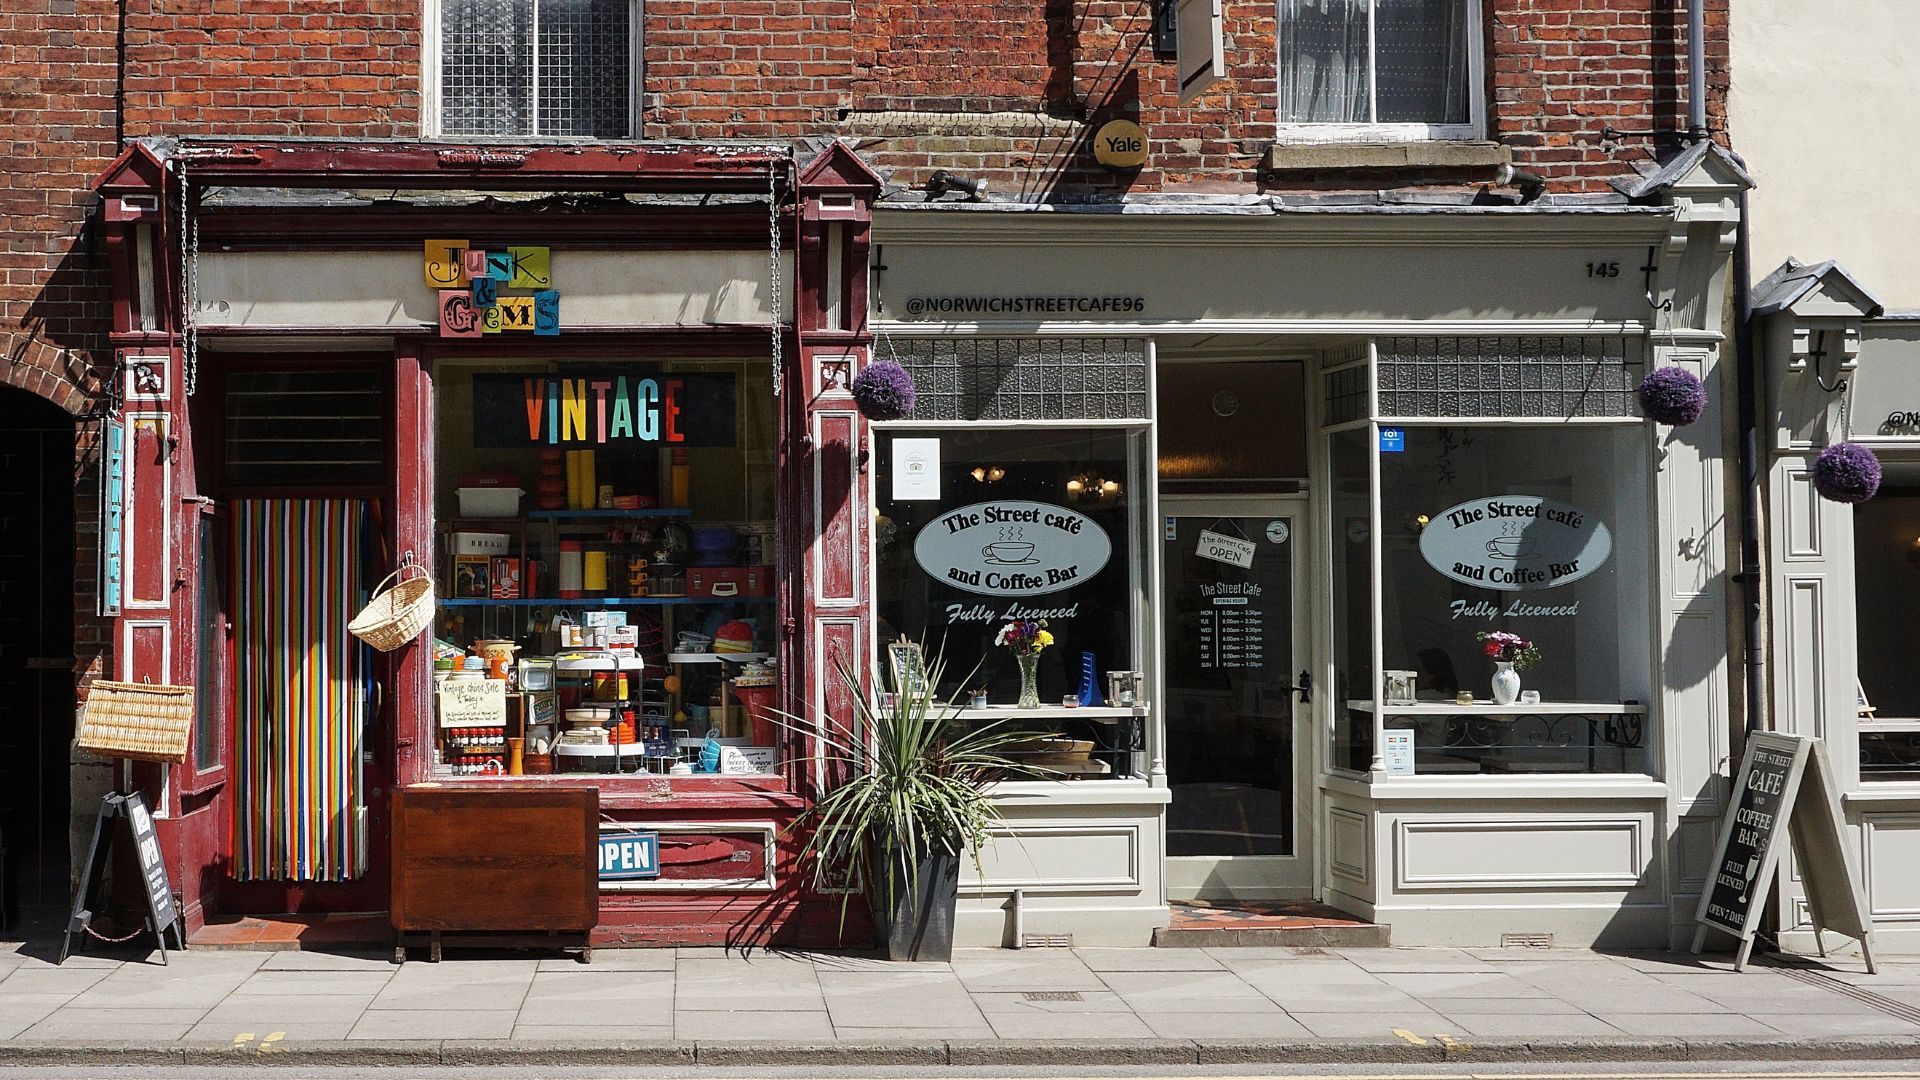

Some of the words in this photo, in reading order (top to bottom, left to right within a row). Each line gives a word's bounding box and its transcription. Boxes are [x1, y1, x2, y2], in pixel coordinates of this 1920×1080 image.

[1106, 136, 1141, 153] Yale
[1586, 262, 1620, 278] 145
[475, 277, 496, 305] &
[906, 296, 1145, 315] @NORWICHSTREETCAFE96
[524, 375, 685, 444] VINTAGE
[1888, 411, 1920, 428] @N
[942, 512, 980, 535] The
[984, 506, 1041, 525] Street
[1044, 512, 1084, 535] café
[1447, 508, 1484, 530] The
[1487, 500, 1543, 519] Street
[1546, 507, 1584, 530] café
[471, 540, 502, 549] BREAD
[1202, 536, 1216, 544] The
[1216, 536, 1237, 548] Street
[1237, 543, 1252, 556] Cafe
[1209, 546, 1242, 563] OPEN
[947, 566, 980, 586] and
[985, 572, 1043, 590] Coffee
[1045, 563, 1078, 586] Bar
[1452, 561, 1485, 581] and
[1489, 566, 1546, 584] Coffee
[1550, 558, 1580, 580] Bar
[1200, 584, 1216, 597] The
[1216, 581, 1242, 595] Street
[1243, 582, 1262, 597] Cafe
[945, 602, 996, 625] Fully
[1000, 601, 1079, 621] Licenced
[1449, 598, 1499, 621] Fully
[1503, 598, 1580, 618] Licenced
[1754, 751, 1767, 763] THE
[1767, 754, 1792, 768] STREET
[1748, 769, 1784, 796] CAFÉ
[1754, 797, 1765, 805] AND
[1737, 807, 1772, 830] COFFEE
[1737, 828, 1758, 848] BAR
[1726, 860, 1744, 875] FULLY
[1718, 873, 1744, 890] LICENCED
[1709, 903, 1725, 918] OPEN
[1724, 909, 1730, 920] 7
[1729, 911, 1744, 925] DAYS
